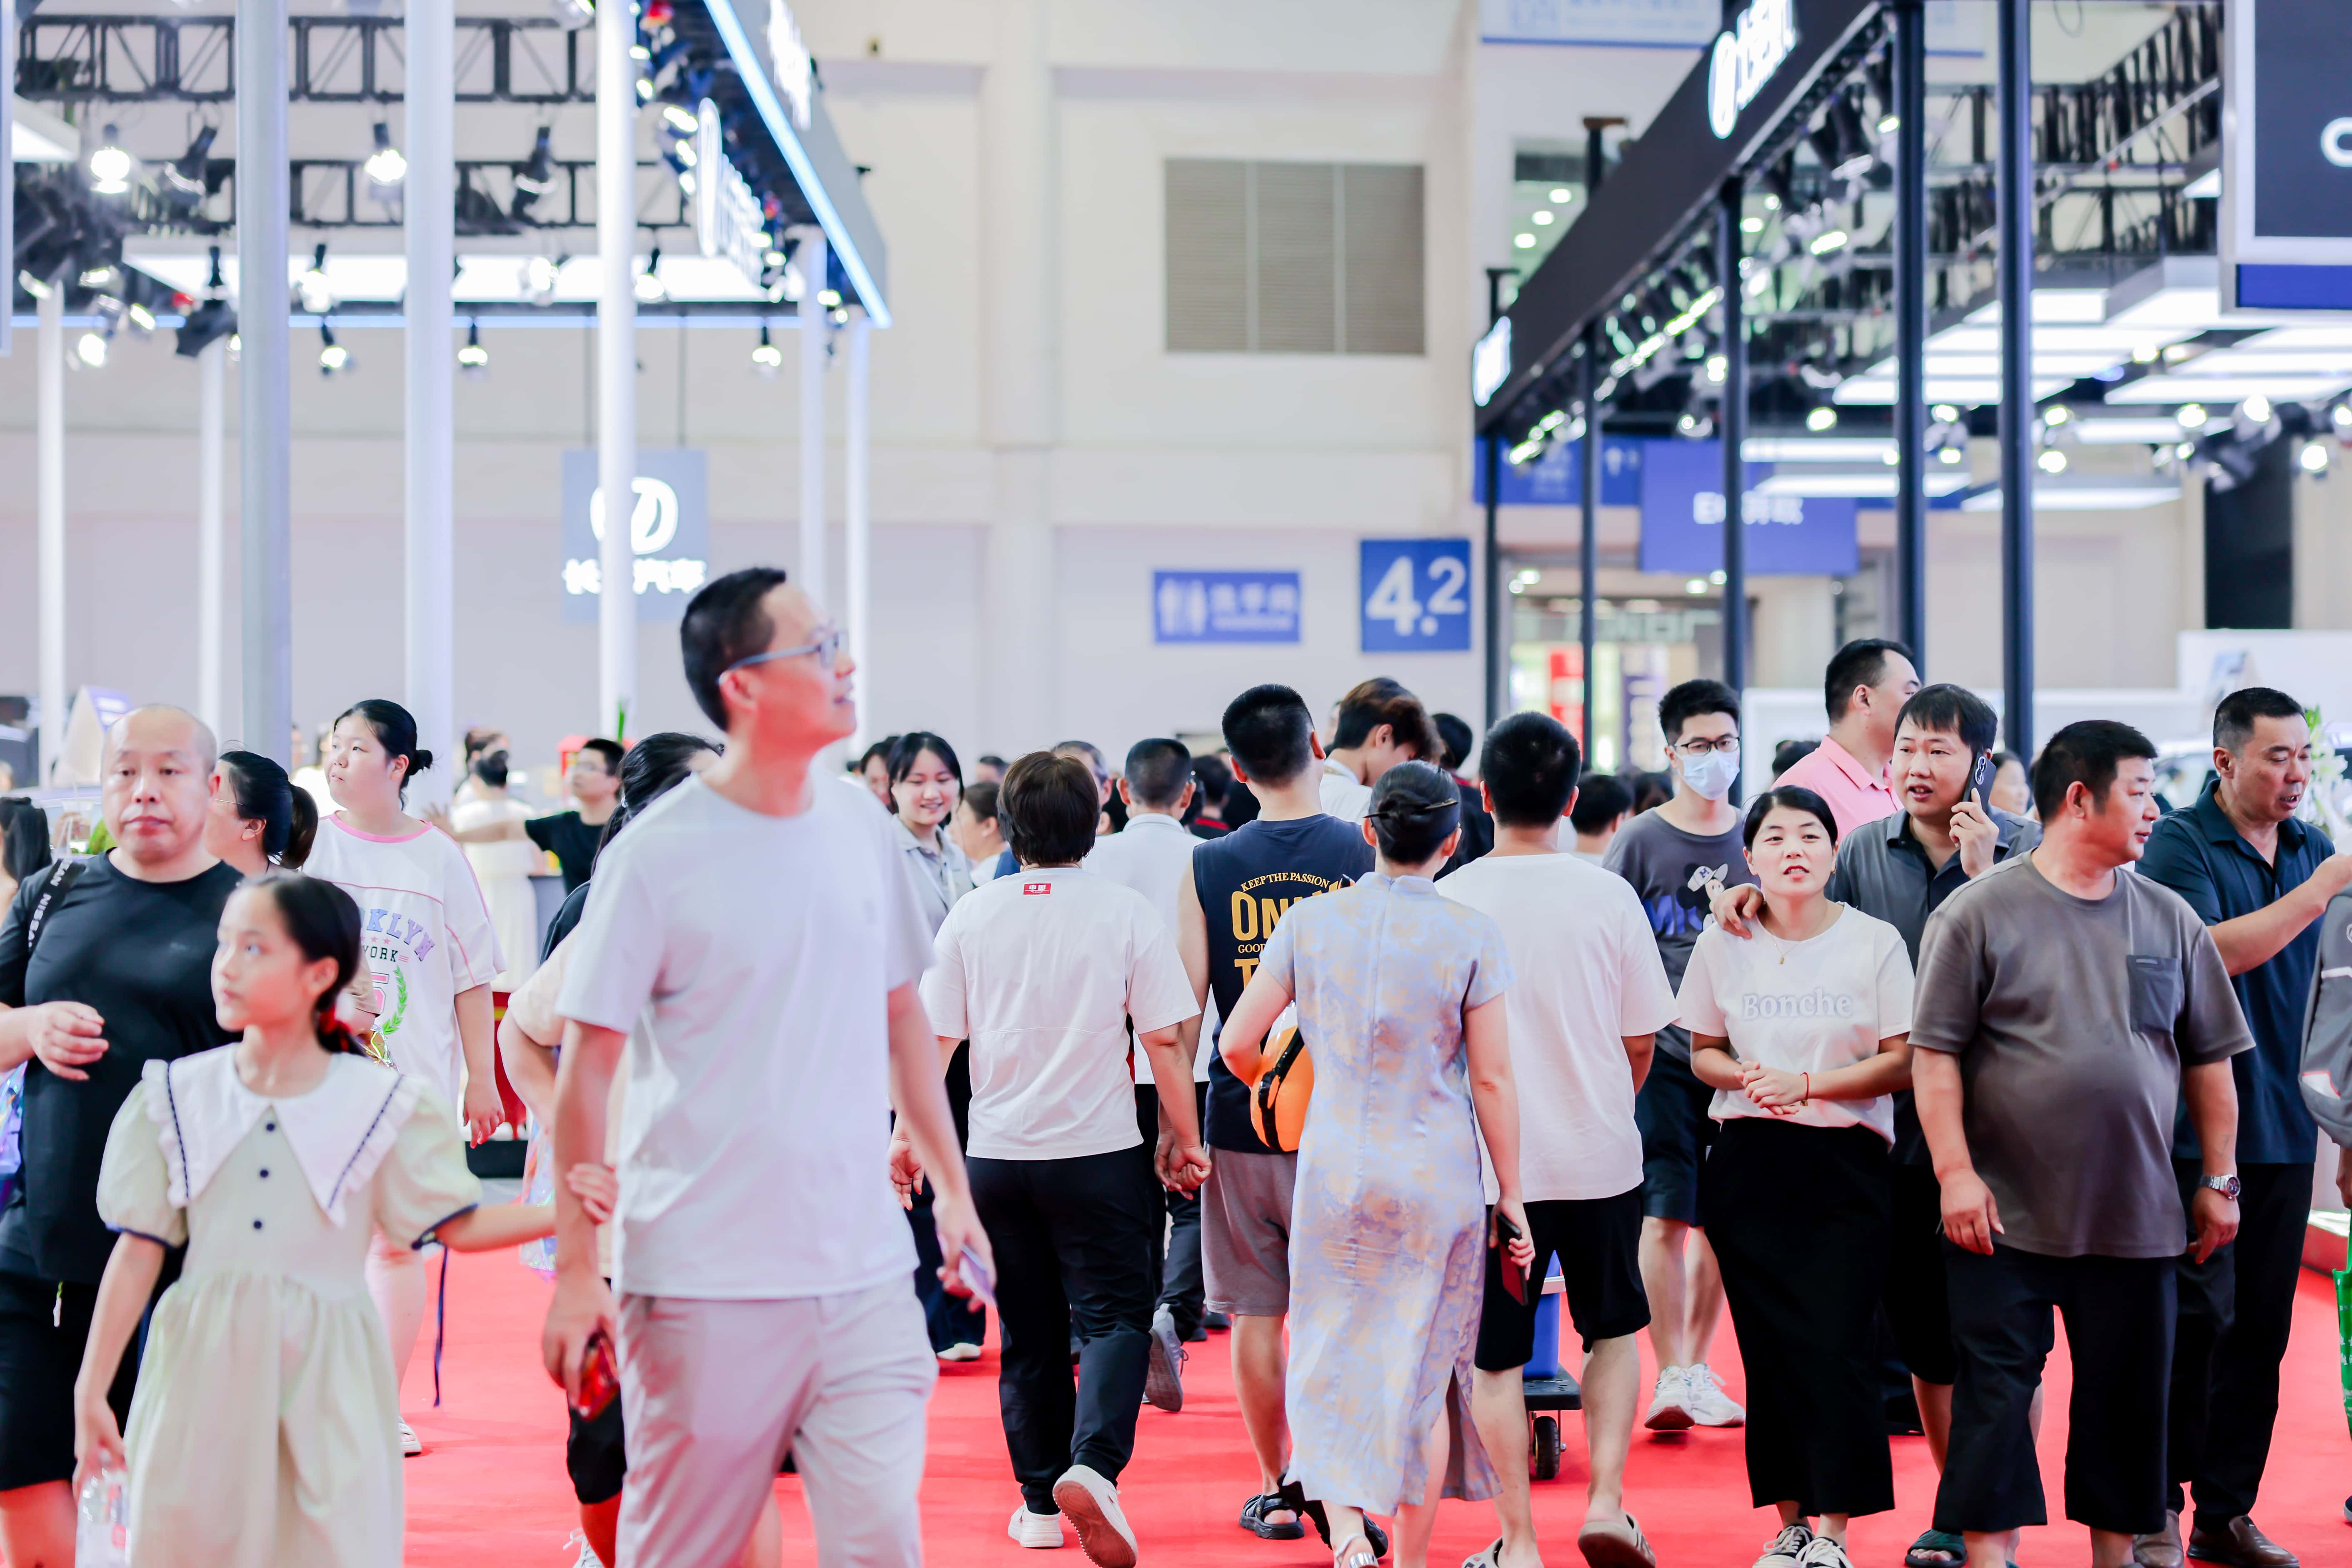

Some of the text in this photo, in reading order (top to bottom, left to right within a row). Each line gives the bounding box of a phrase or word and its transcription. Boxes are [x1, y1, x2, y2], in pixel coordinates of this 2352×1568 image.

[1365, 556, 1467, 636] 4.2
[1240, 872, 1330, 892] KEEP THE PASSION
[360, 907, 436, 962] KLYN
[363, 945, 398, 962] YORK
[1743, 986, 1854, 1021] Bonche
